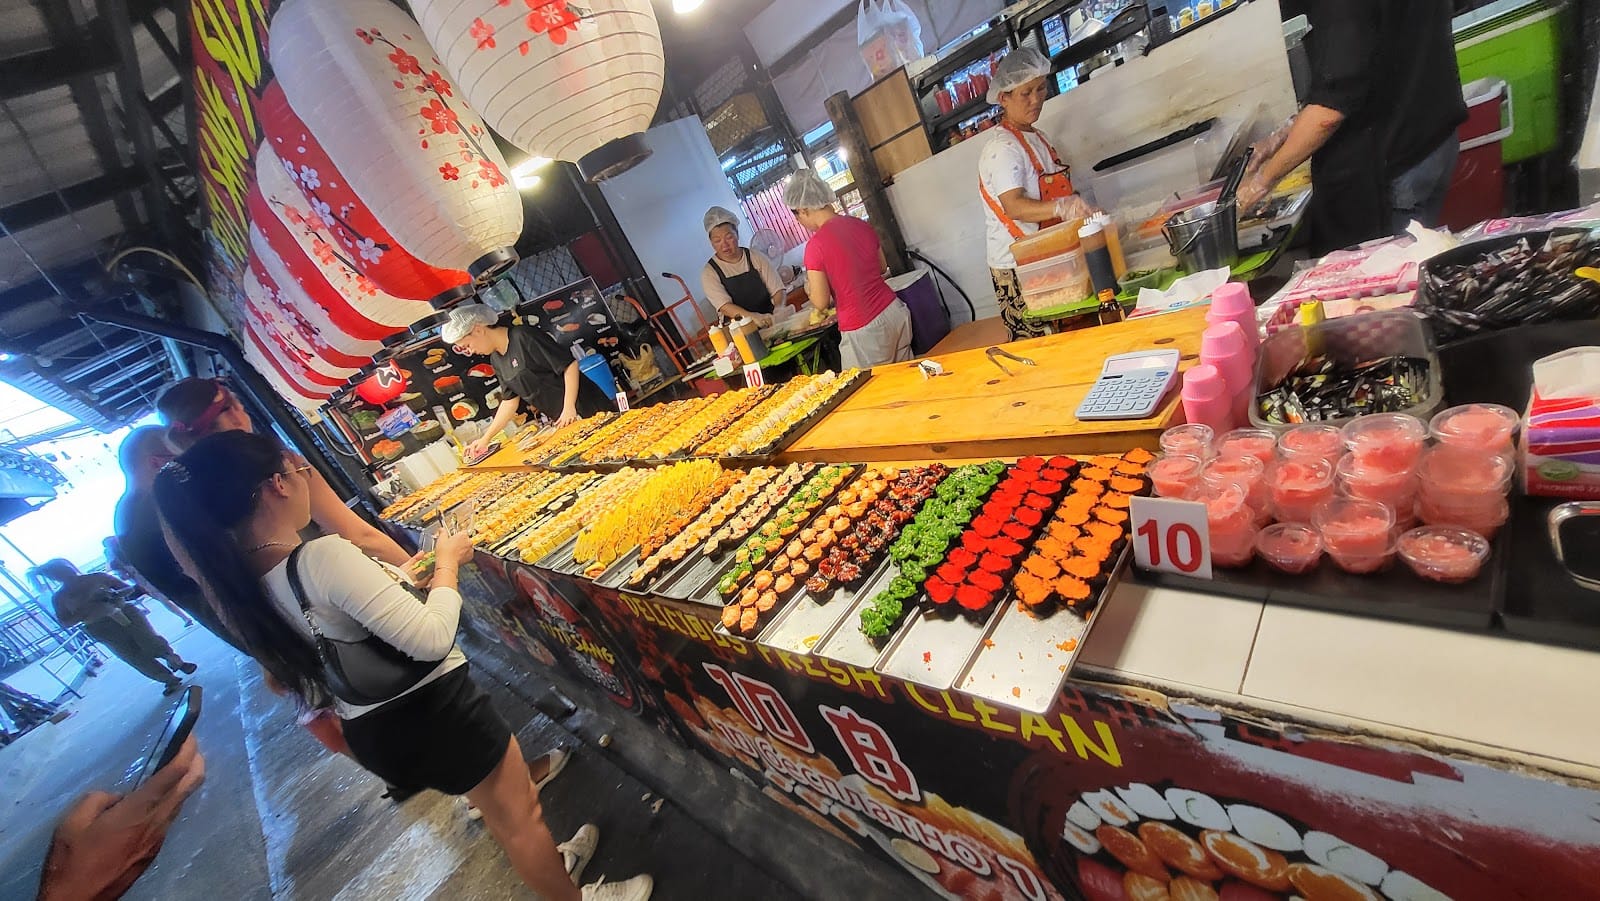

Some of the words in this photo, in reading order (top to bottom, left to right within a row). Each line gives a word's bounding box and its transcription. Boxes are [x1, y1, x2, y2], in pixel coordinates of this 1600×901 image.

[618, 397, 628, 411] 10
[746, 369, 761, 388] 10
[1138, 519, 1203, 573] 10
[619, 592, 748, 655] DELICIOUS
[755, 641, 888, 697] FRESH
[904, 682, 1123, 768] CLEAN
[702, 662, 815, 754] 10
[754, 736, 992, 876] бесплатно
